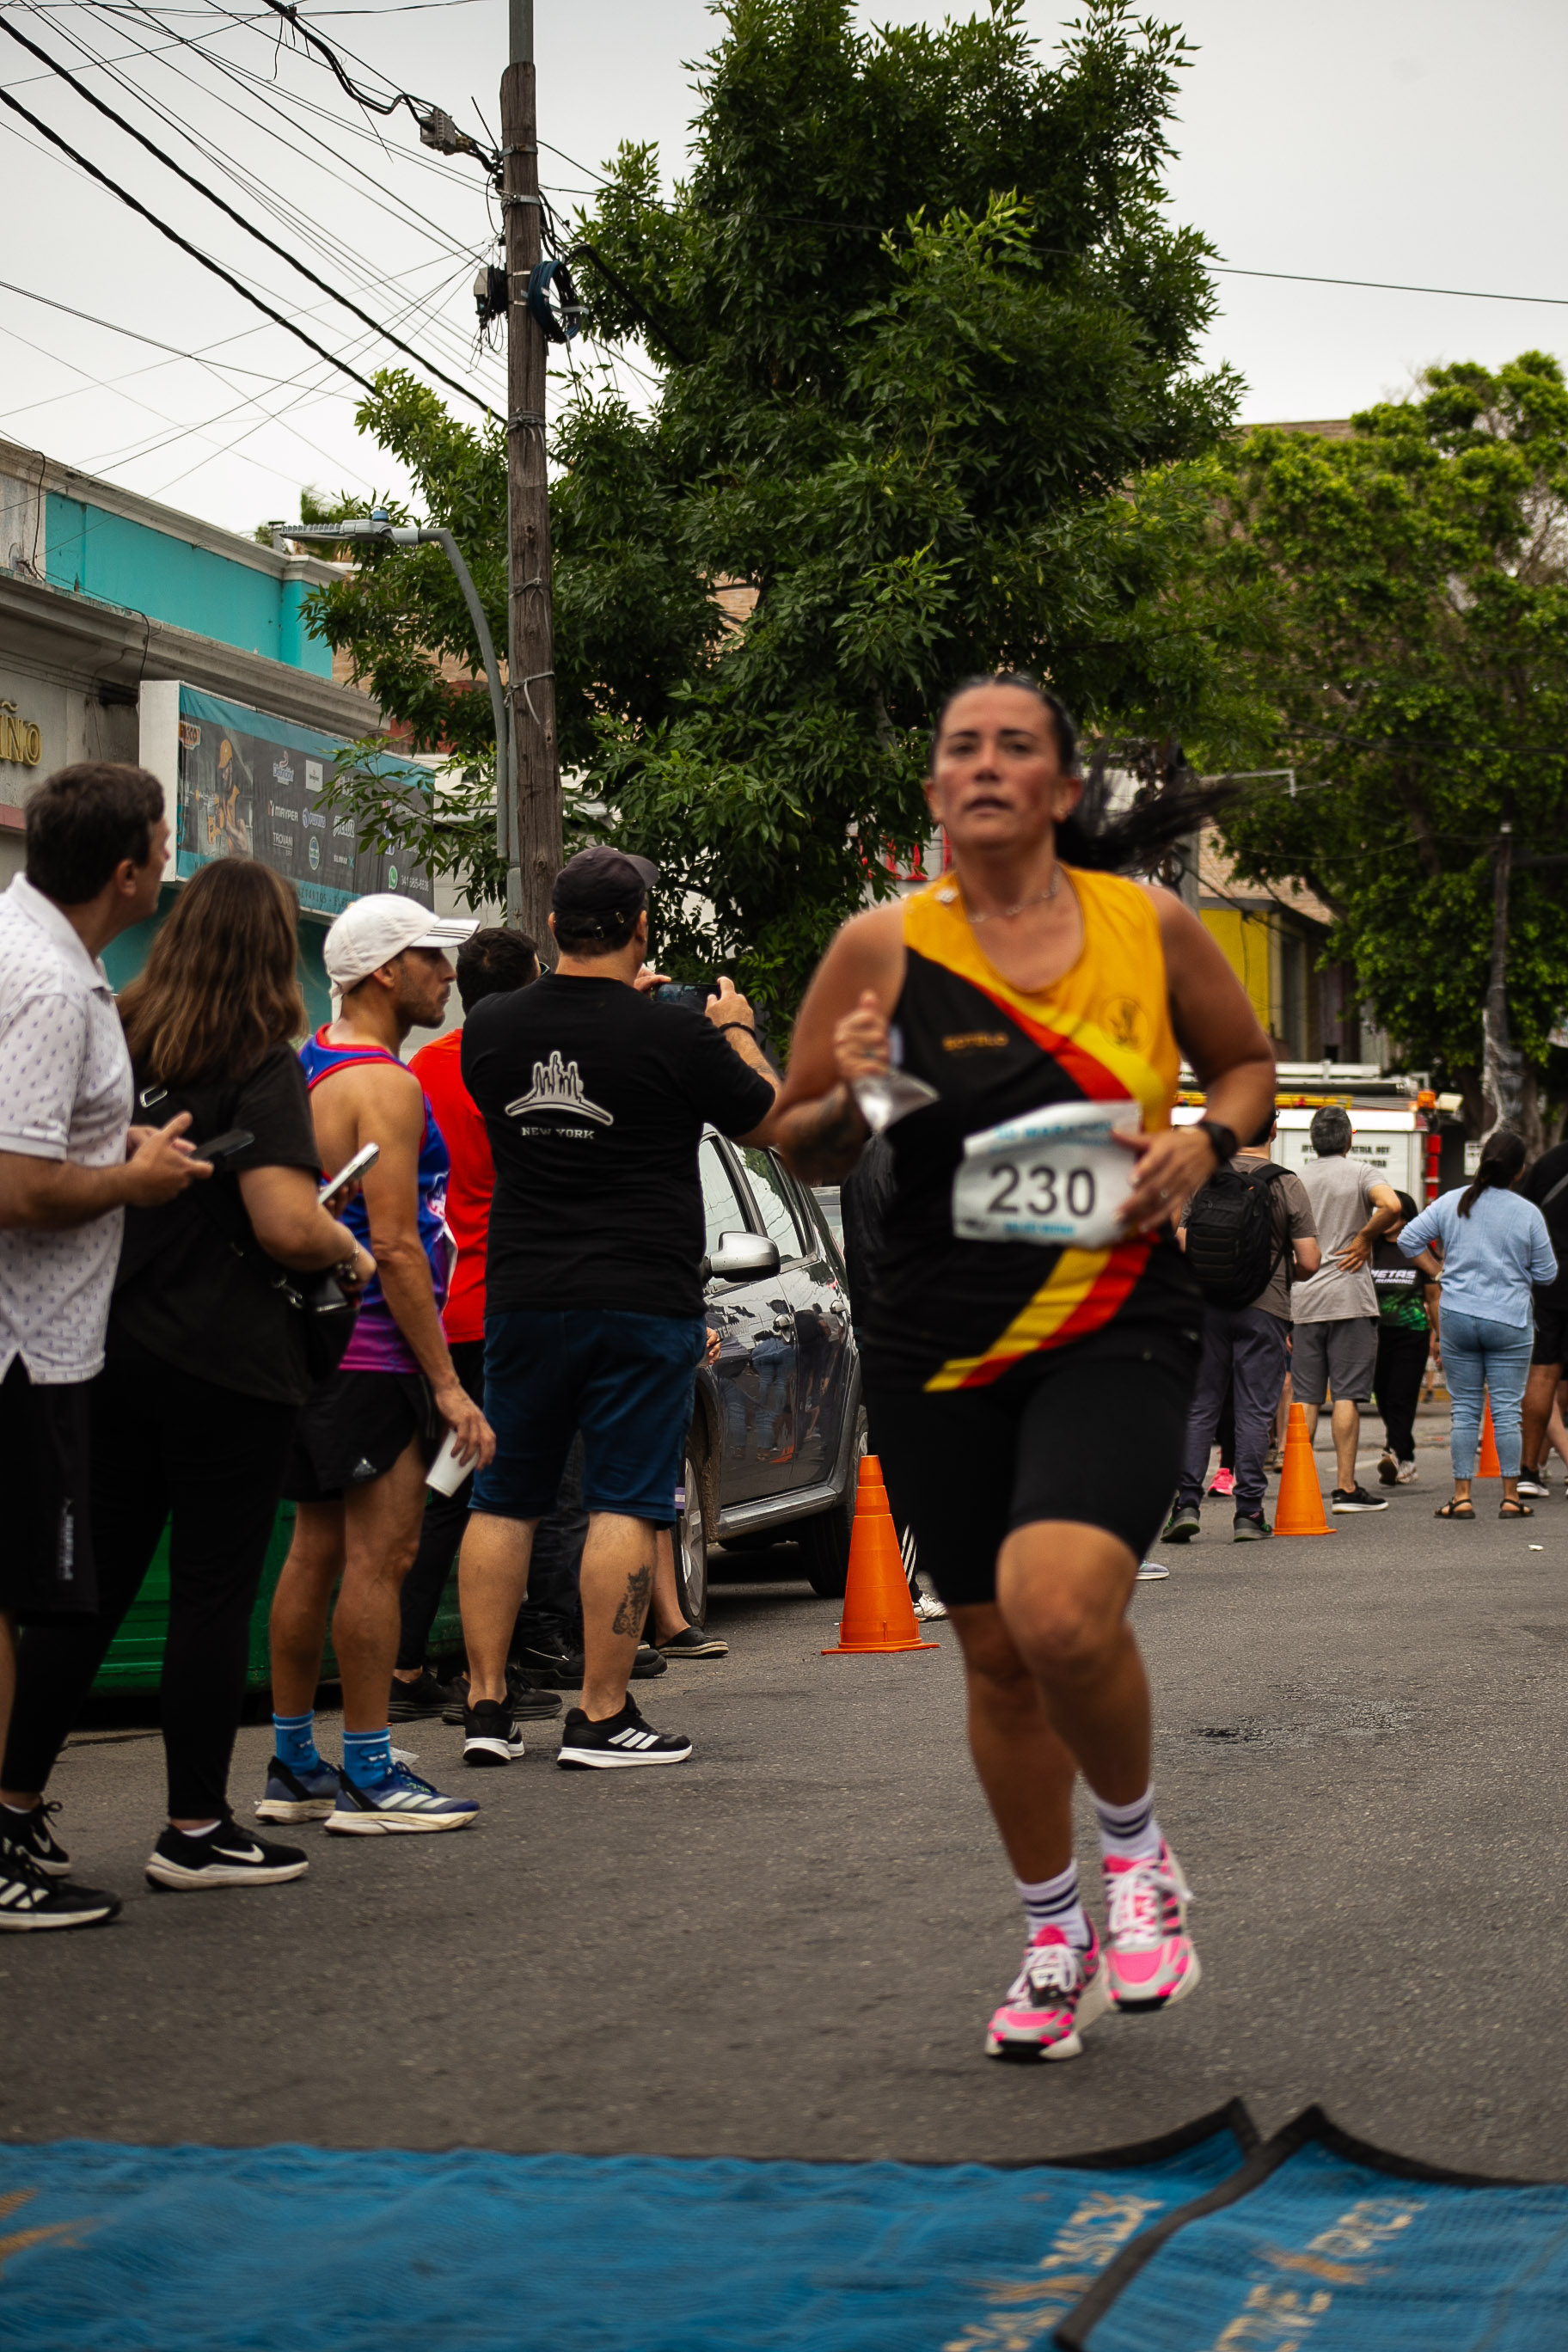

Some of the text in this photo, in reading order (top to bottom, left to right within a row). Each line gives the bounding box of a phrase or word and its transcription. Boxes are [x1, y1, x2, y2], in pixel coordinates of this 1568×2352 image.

[0, 701, 42, 766] ÑO
[521, 1127, 595, 1139] NEW YORK
[988, 1162, 1095, 1218] 230
